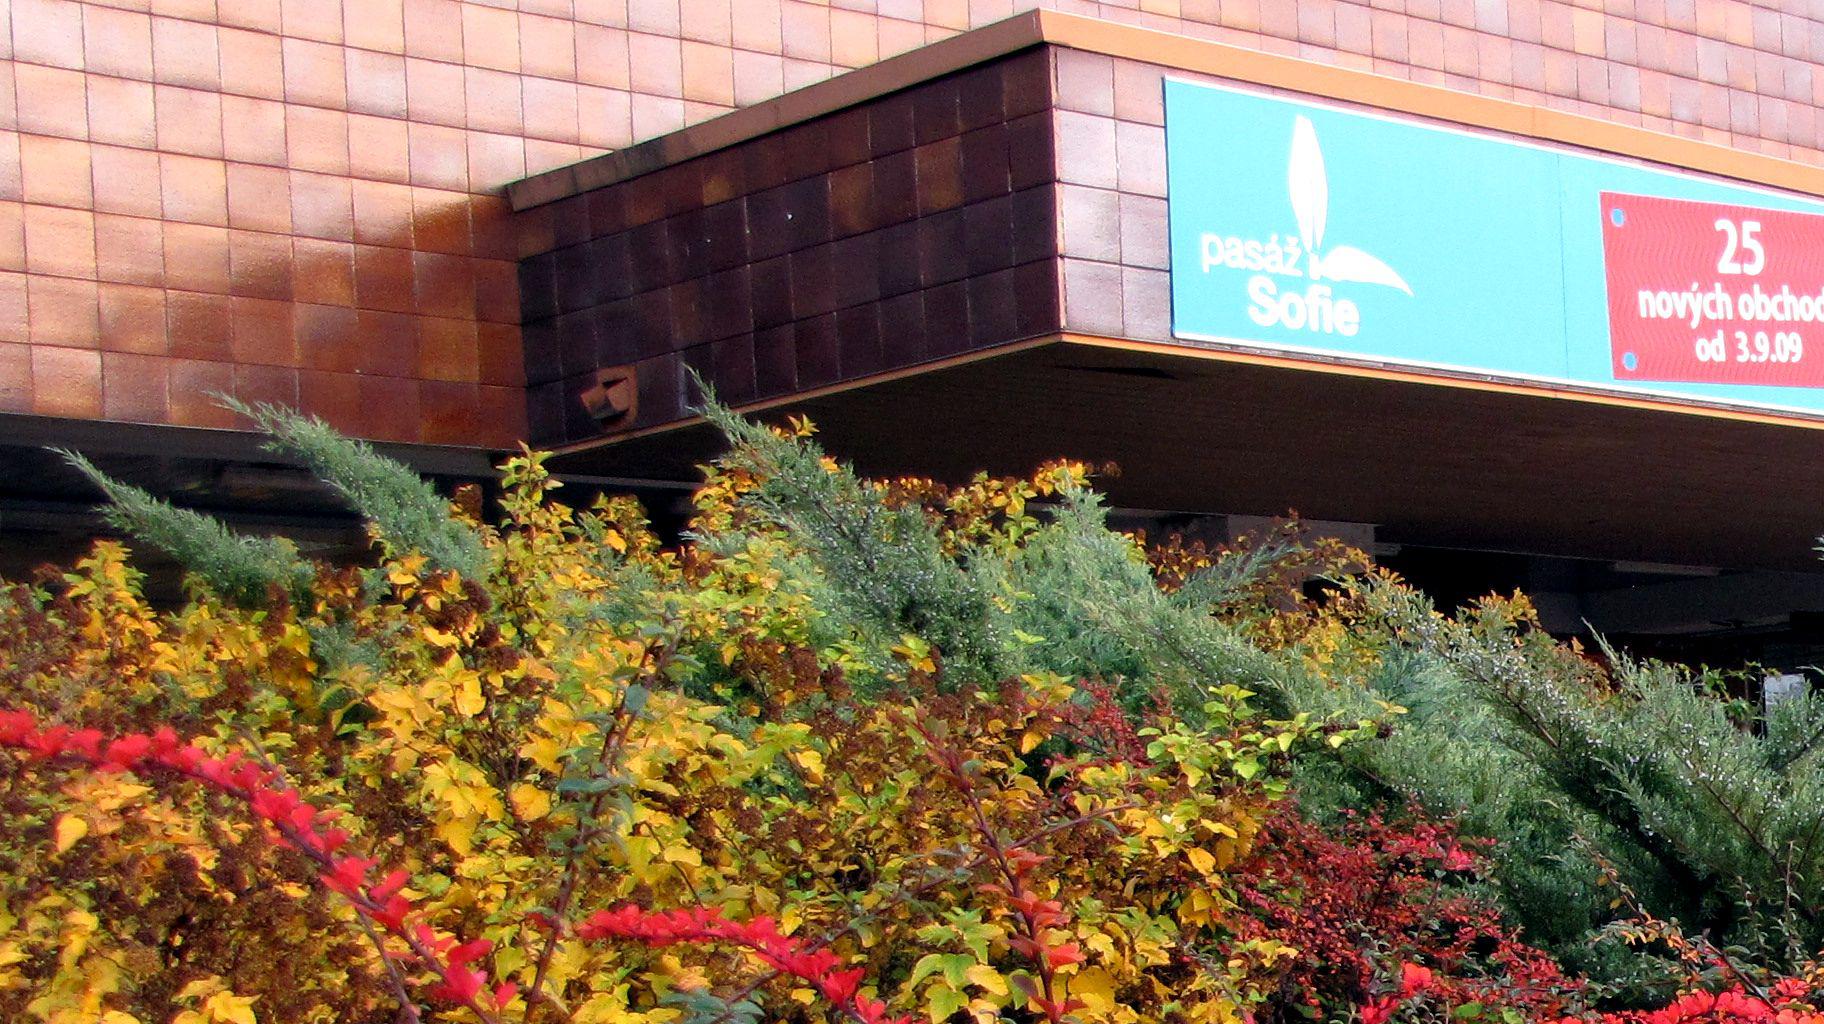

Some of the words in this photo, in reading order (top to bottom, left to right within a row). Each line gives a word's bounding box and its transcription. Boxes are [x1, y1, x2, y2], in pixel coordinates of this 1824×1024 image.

[1201, 233, 1303, 276] pasáž
[1714, 217, 1766, 276] 25
[1247, 275, 1361, 337] Sofie
[1638, 281, 1733, 329] nových
[1695, 329, 1726, 363] od
[1735, 331, 1803, 363] 3.9.09
